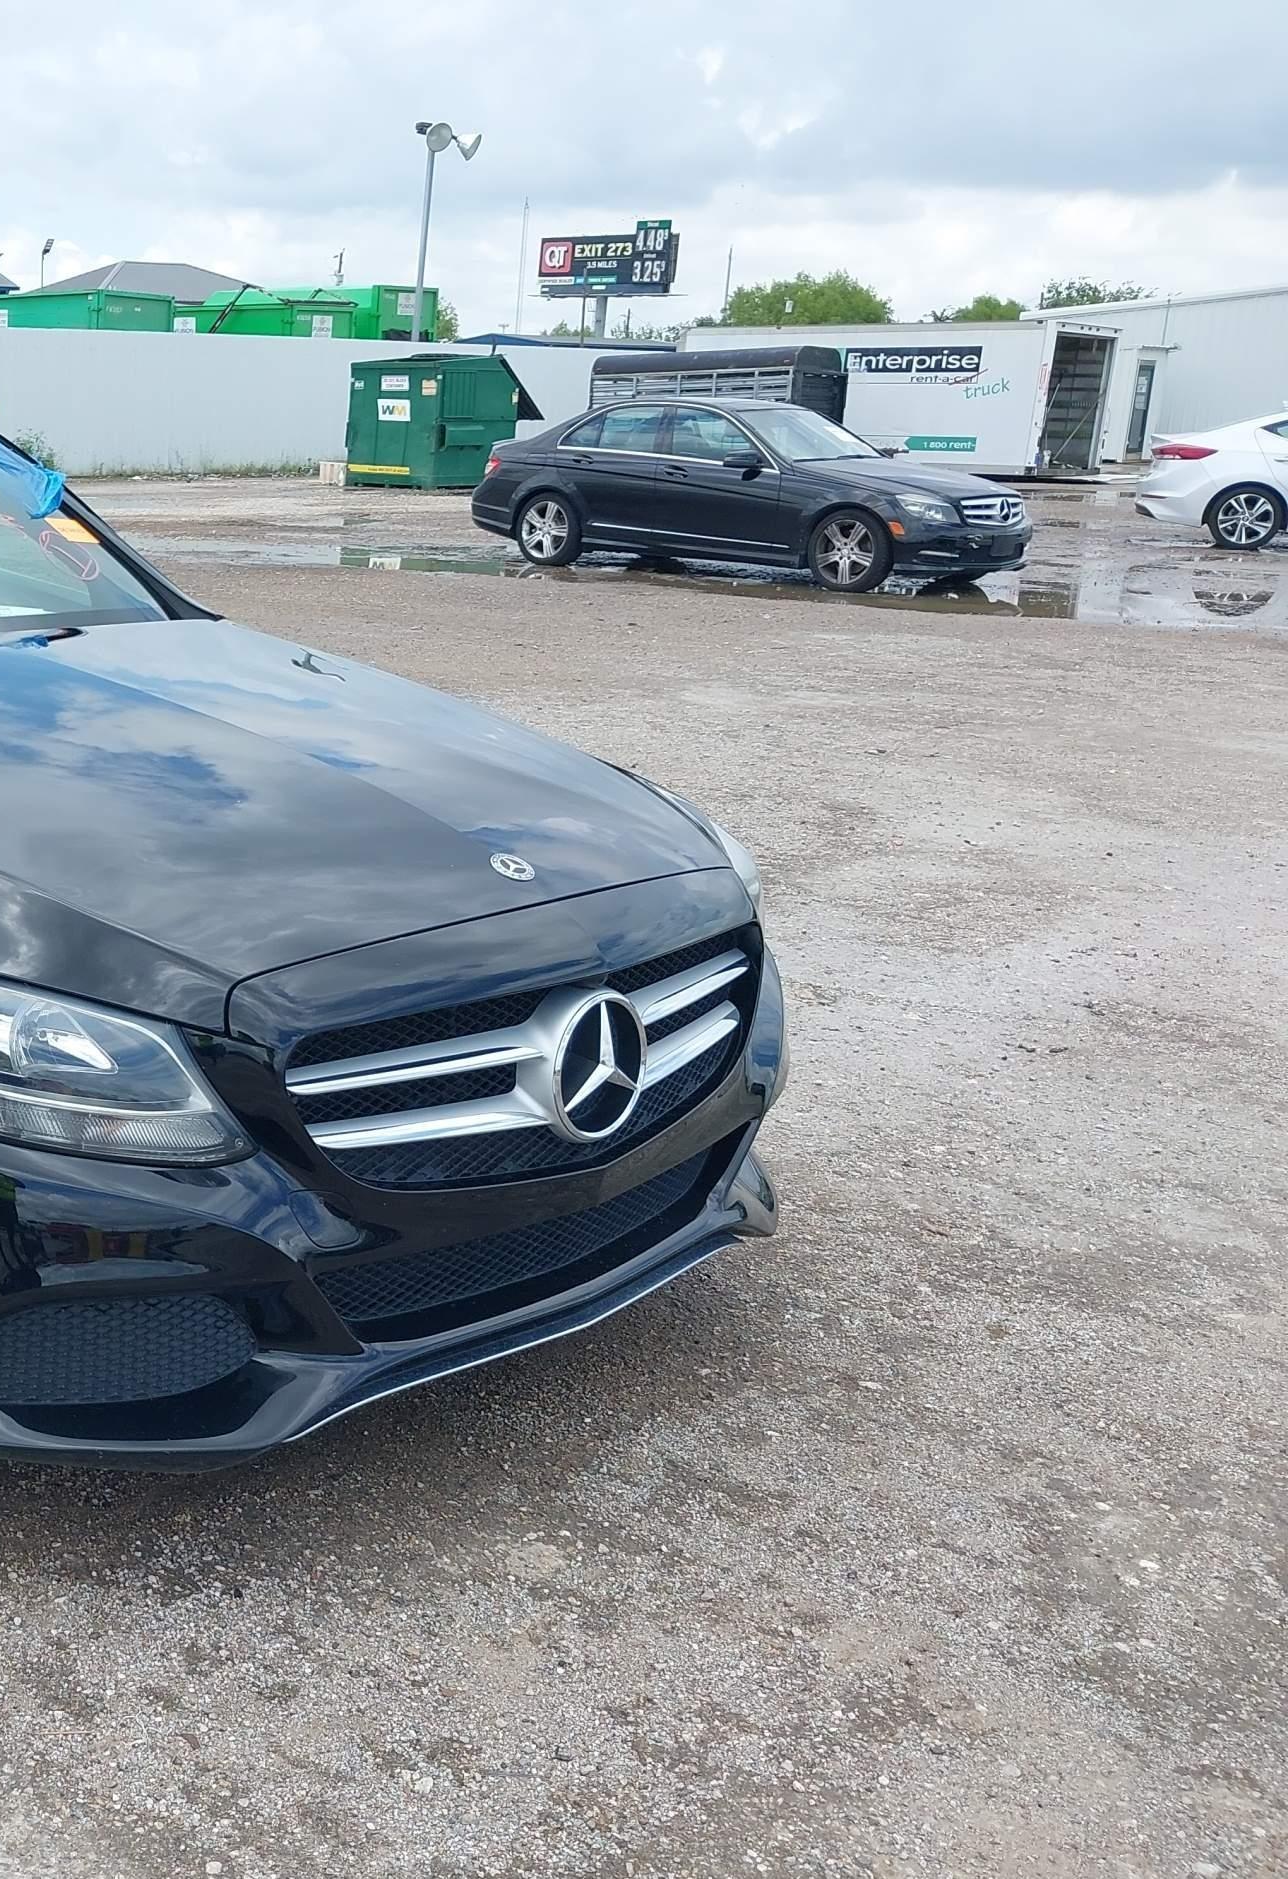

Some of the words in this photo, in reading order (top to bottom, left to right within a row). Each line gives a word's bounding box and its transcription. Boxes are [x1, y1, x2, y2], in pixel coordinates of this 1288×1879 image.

[545, 246, 568, 268] QT
[574, 243, 605, 258] EXIT
[606, 242, 633, 257] 273
[597, 260, 618, 269] MILES
[846, 350, 979, 373] Enterprise
[910, 374, 975, 385] rent-a-car
[963, 378, 1010, 399] truck
[381, 404, 408, 417] WM
[929, 441, 948, 449] 800
[949, 439, 977, 449] rent-
